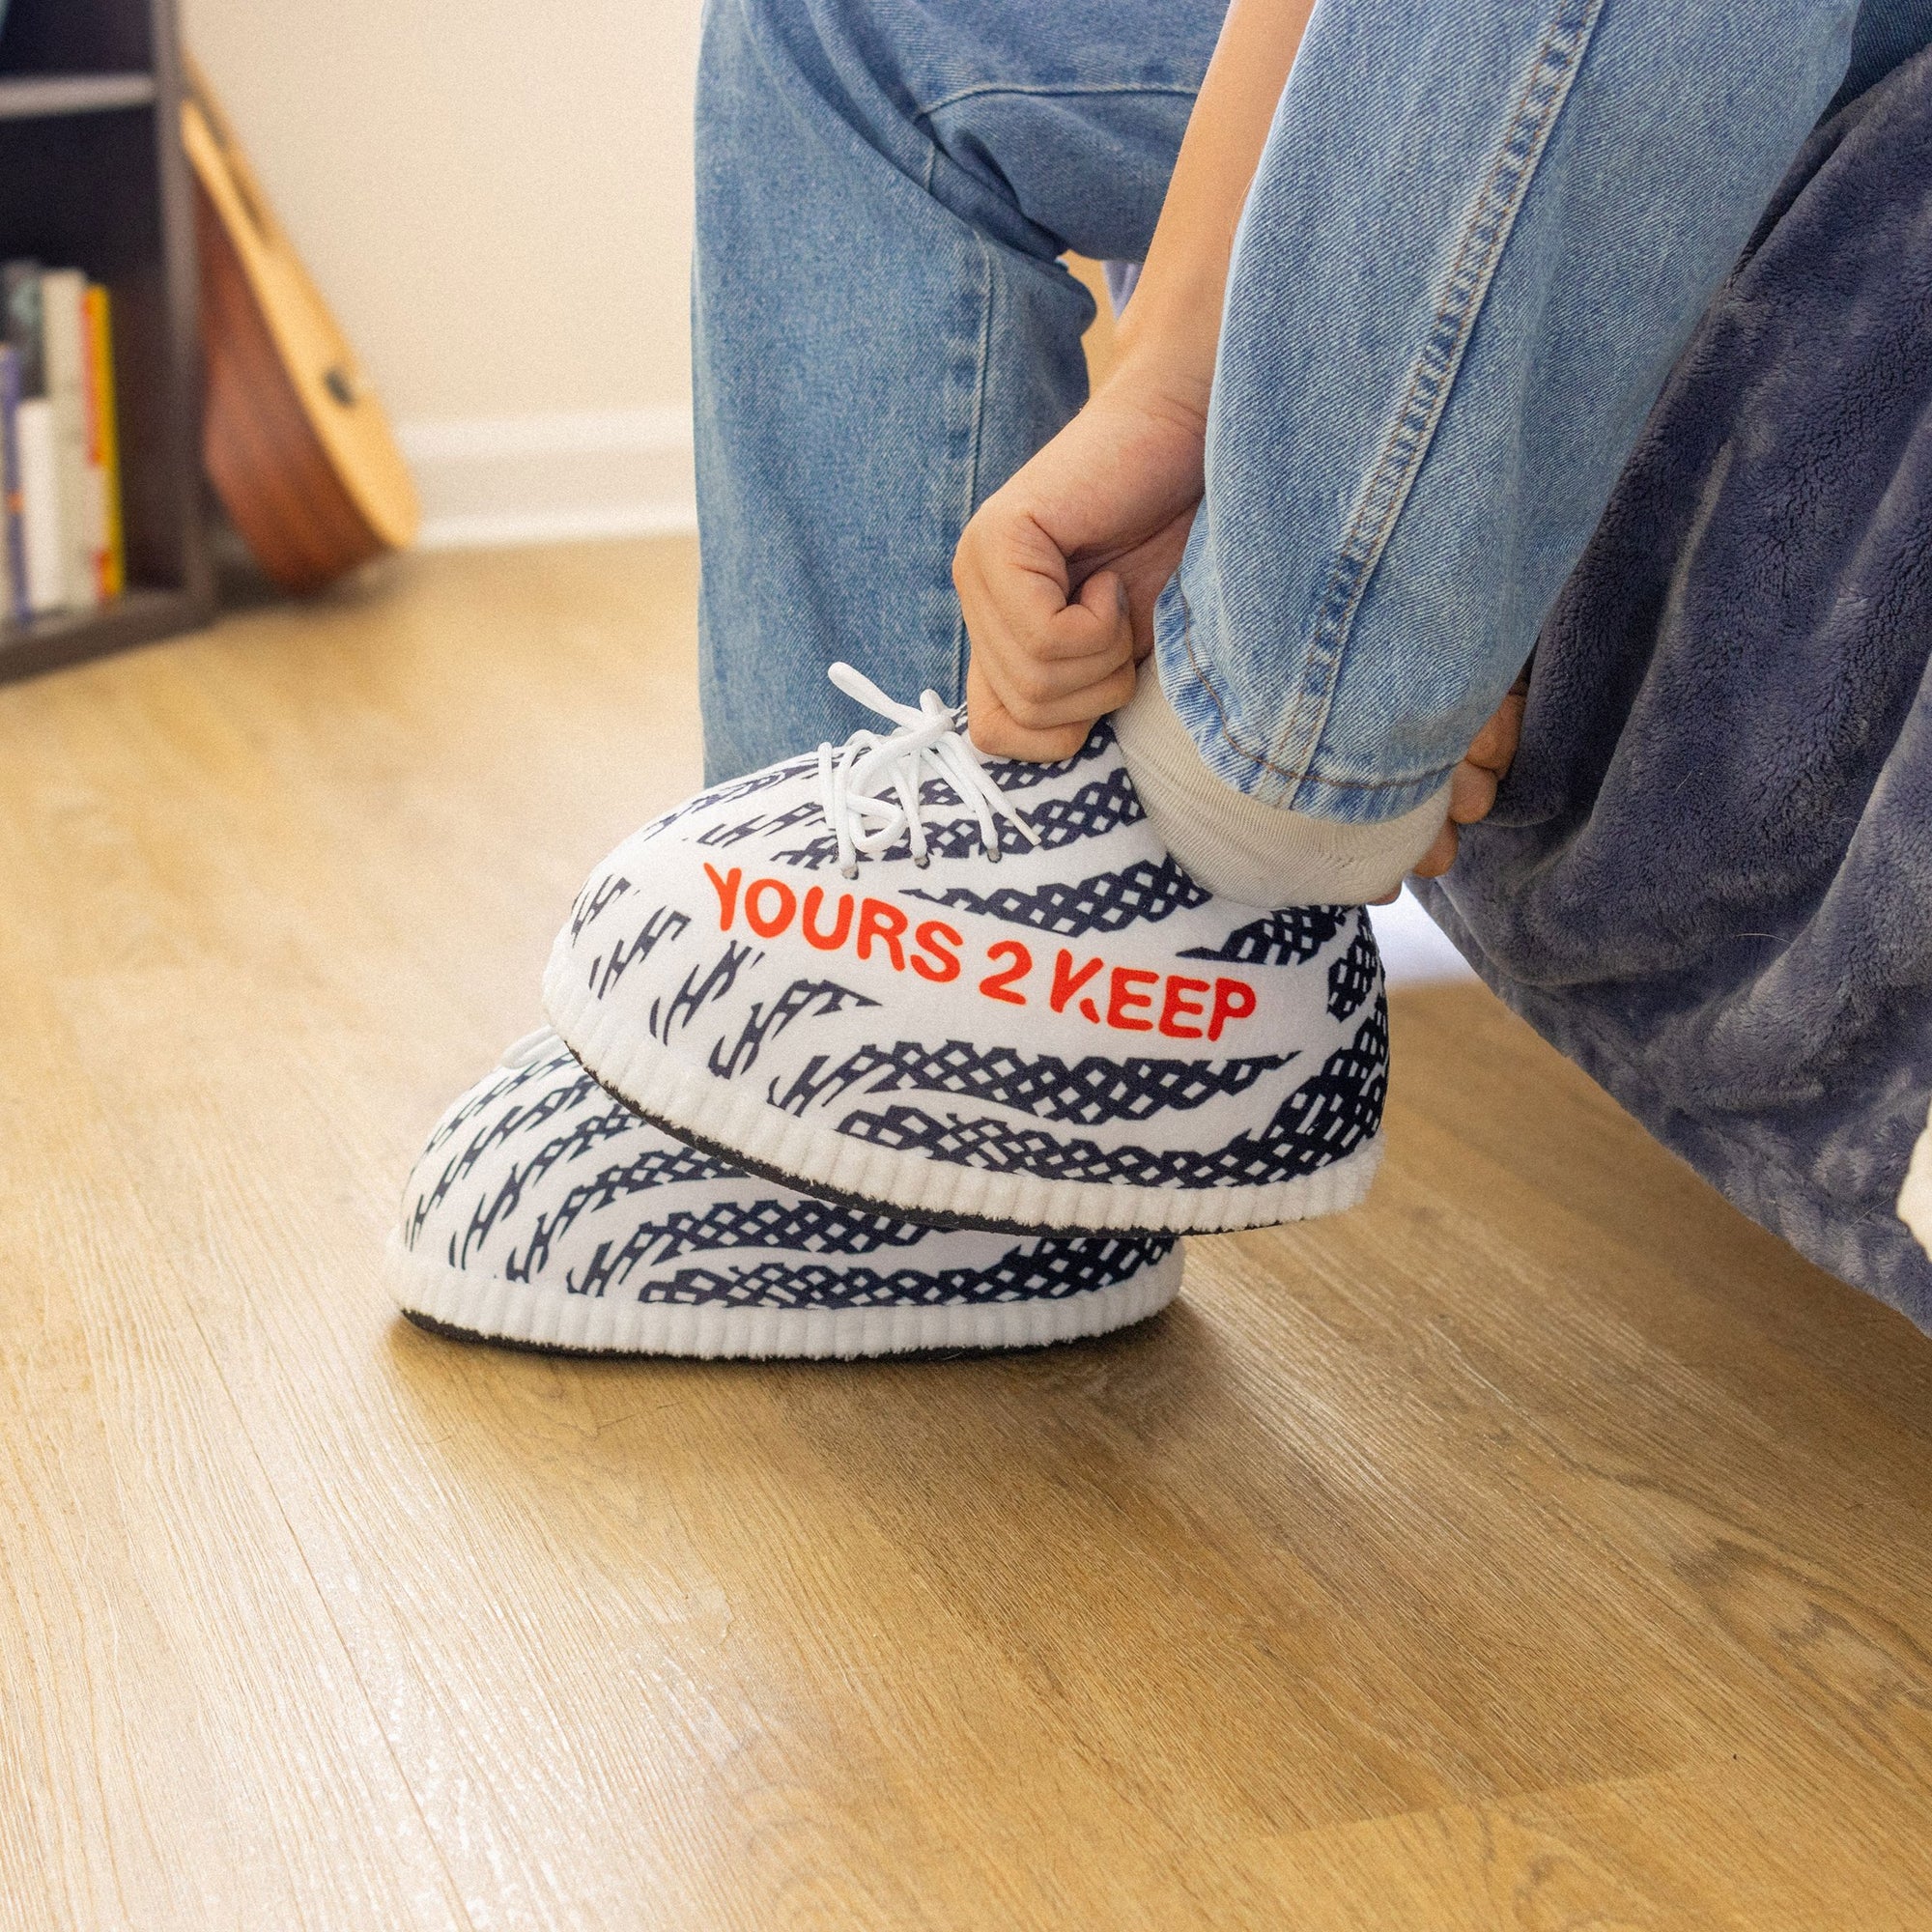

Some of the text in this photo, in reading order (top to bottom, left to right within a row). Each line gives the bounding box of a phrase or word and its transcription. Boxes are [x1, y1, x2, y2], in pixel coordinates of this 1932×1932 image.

[703, 863, 1258, 1041] YOURS 2 KEEP
